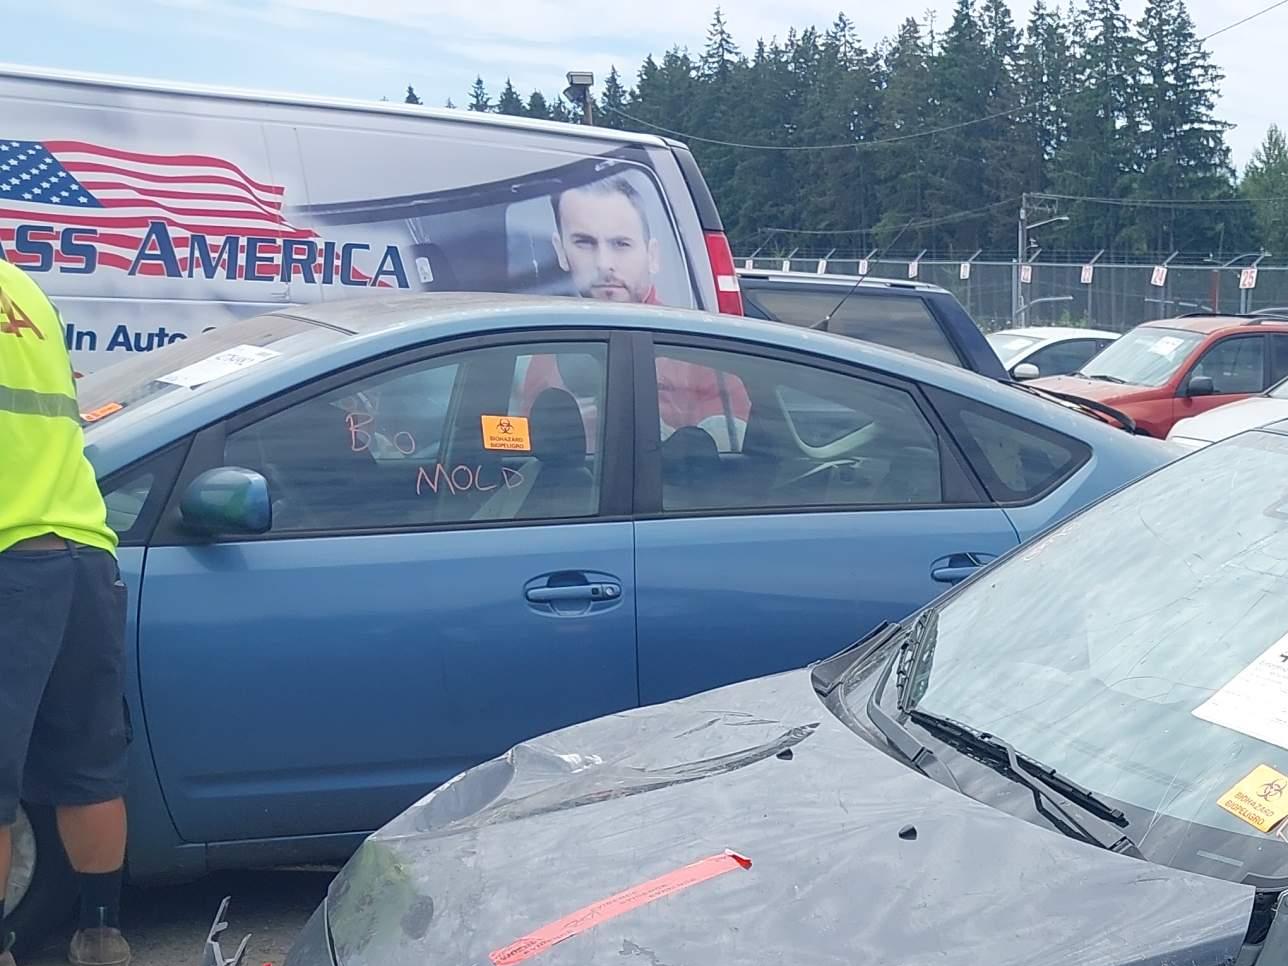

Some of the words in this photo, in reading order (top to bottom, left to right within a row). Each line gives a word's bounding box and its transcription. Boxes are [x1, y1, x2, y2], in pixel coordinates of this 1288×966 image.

[0, 224, 97, 275] SS
[128, 220, 410, 289] AMERICA
[1241, 271, 1255, 287] 25
[66, 323, 98, 351] In
[416, 463, 525, 496] MOLD
[1224, 800, 1266, 826] BIOPELIGRO
[1233, 792, 1275, 818] BIOHAZARD
